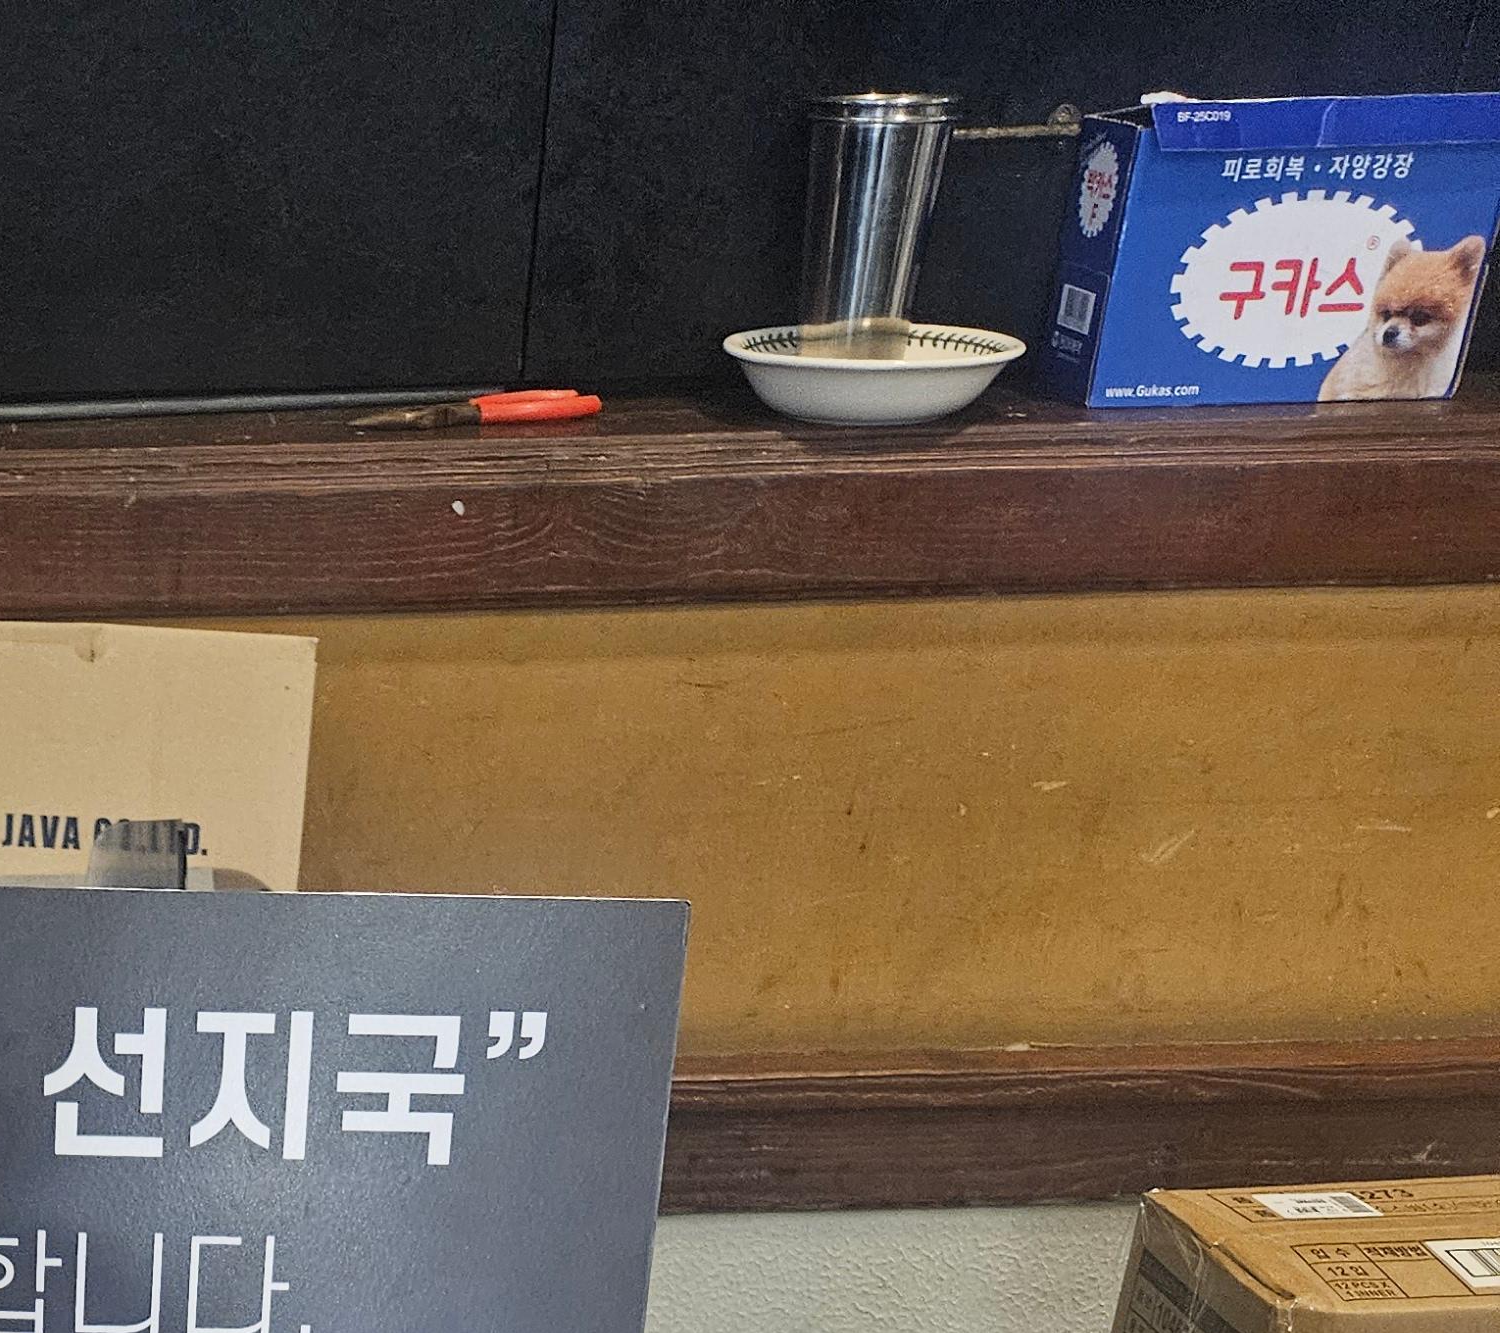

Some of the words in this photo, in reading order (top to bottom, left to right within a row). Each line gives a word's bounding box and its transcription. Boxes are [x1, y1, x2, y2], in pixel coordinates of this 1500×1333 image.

[1221, 155, 1305, 182] 피로회복
[1329, 152, 1414, 180] 자양강장
[1218, 256, 1365, 321] 구카스
[1104, 383, 1200, 399] www.Gukas.com
[1, 812, 82, 850] JAVA
